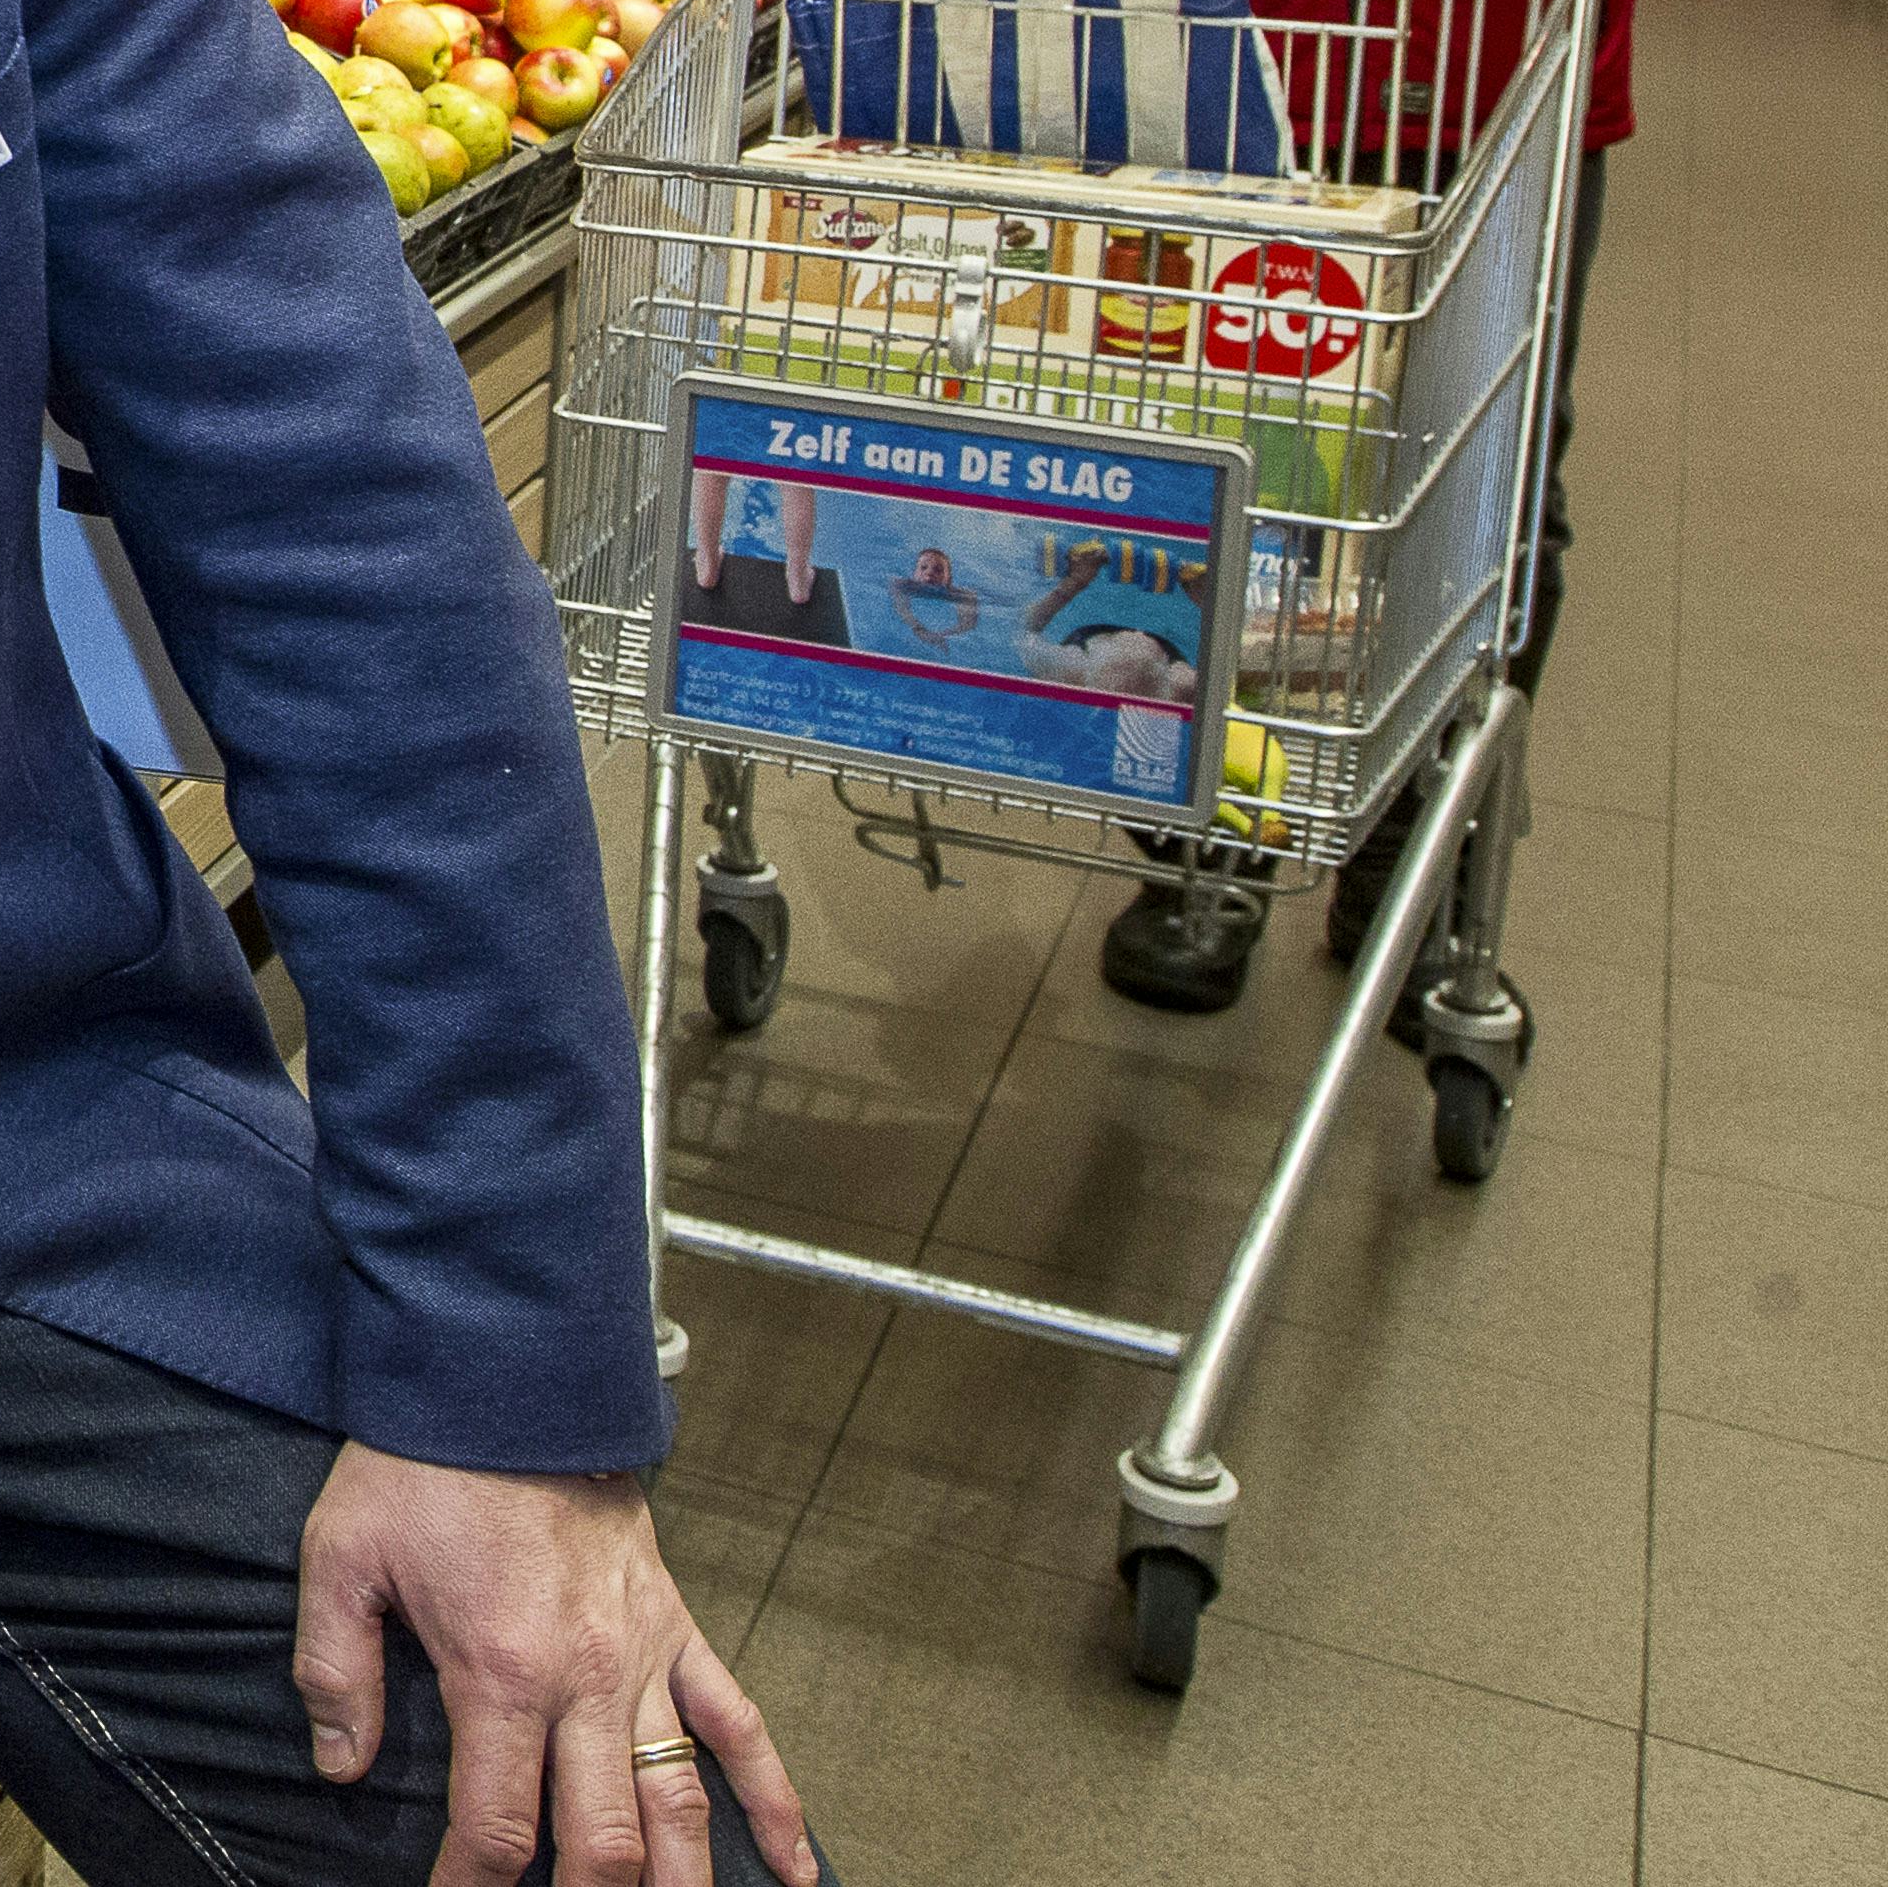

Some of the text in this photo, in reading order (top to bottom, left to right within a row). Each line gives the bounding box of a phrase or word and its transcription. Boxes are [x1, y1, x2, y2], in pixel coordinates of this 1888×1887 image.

[768, 420, 1134, 502] Zelf aan DE SLAG
